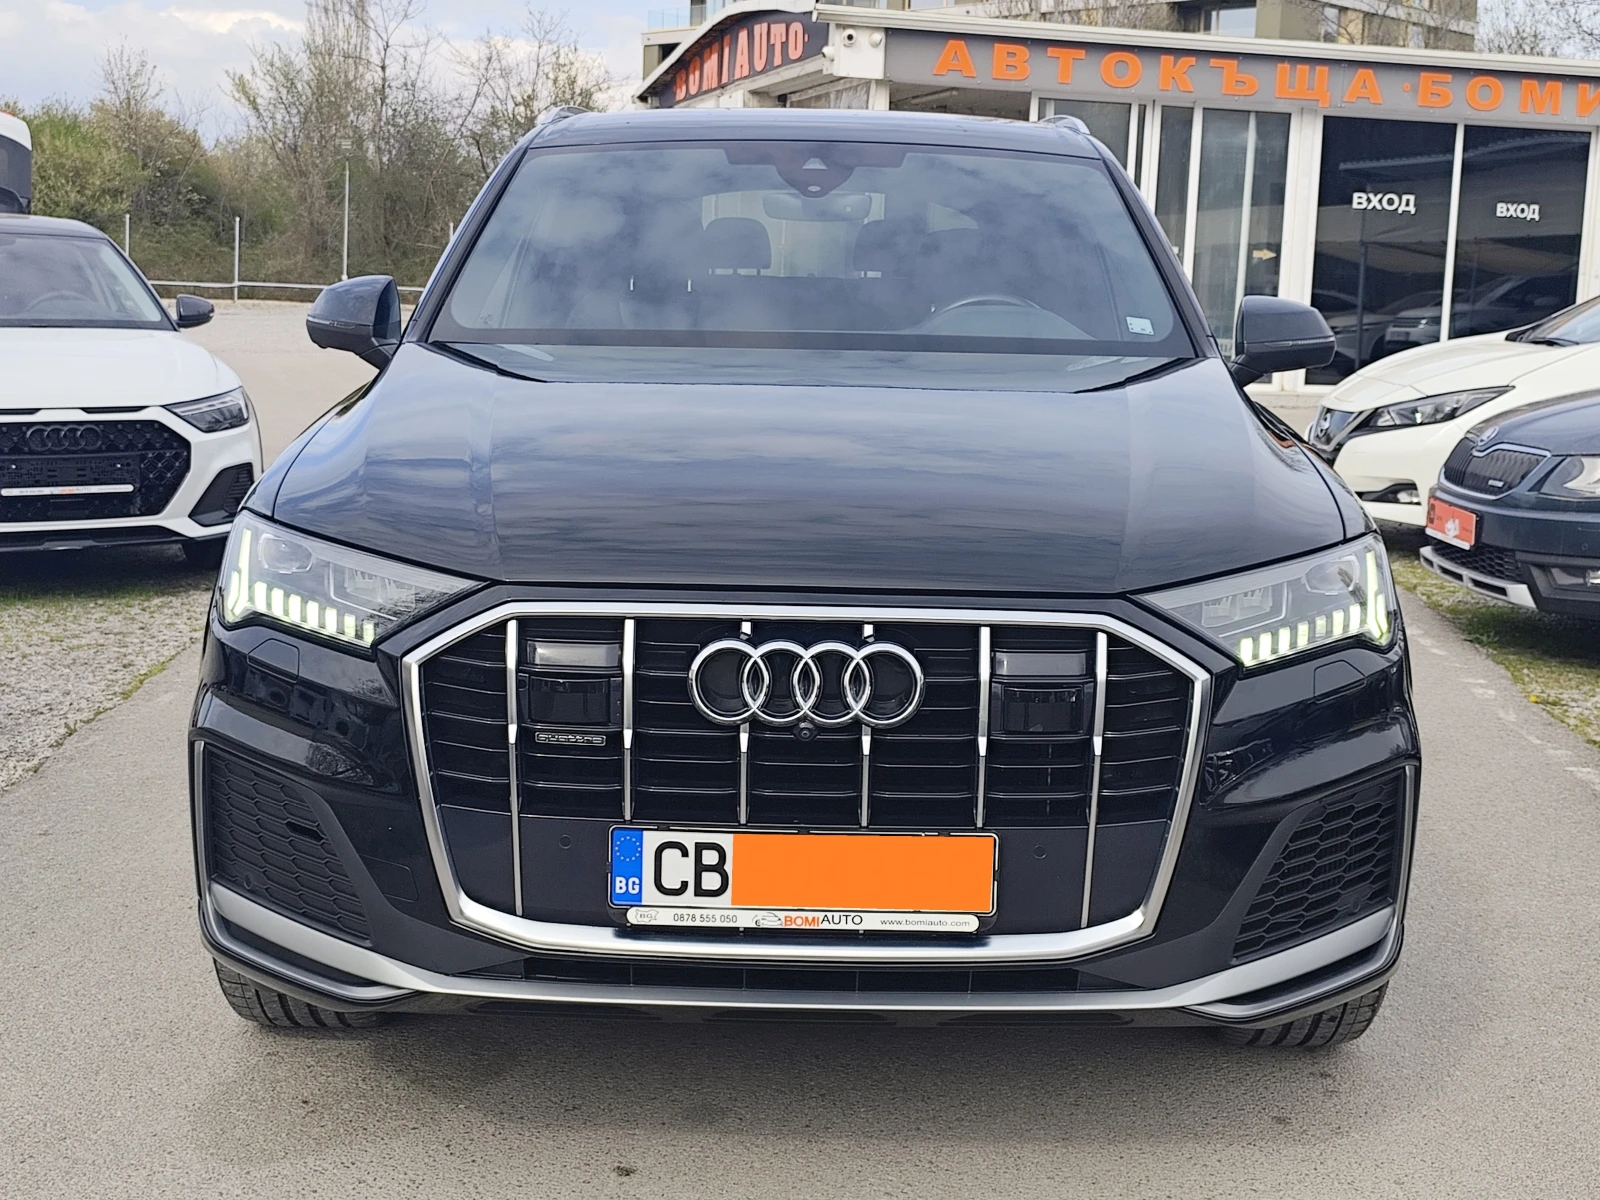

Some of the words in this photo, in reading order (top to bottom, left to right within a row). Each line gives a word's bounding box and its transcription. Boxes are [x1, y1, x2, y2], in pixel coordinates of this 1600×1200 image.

[932, 38, 1384, 108] АВТОКЪЩА
[1352, 192, 1416, 214] ВХОД
[1496, 202, 1540, 221] ВХОД
[653, 840, 730, 898] CB
[615, 876, 640, 895] BG
[673, 912, 697, 922] 0878
[699, 914, 717, 923] 555
[719, 914, 738, 924] 050
[880, 919, 971, 928] www.bomiauto.com
